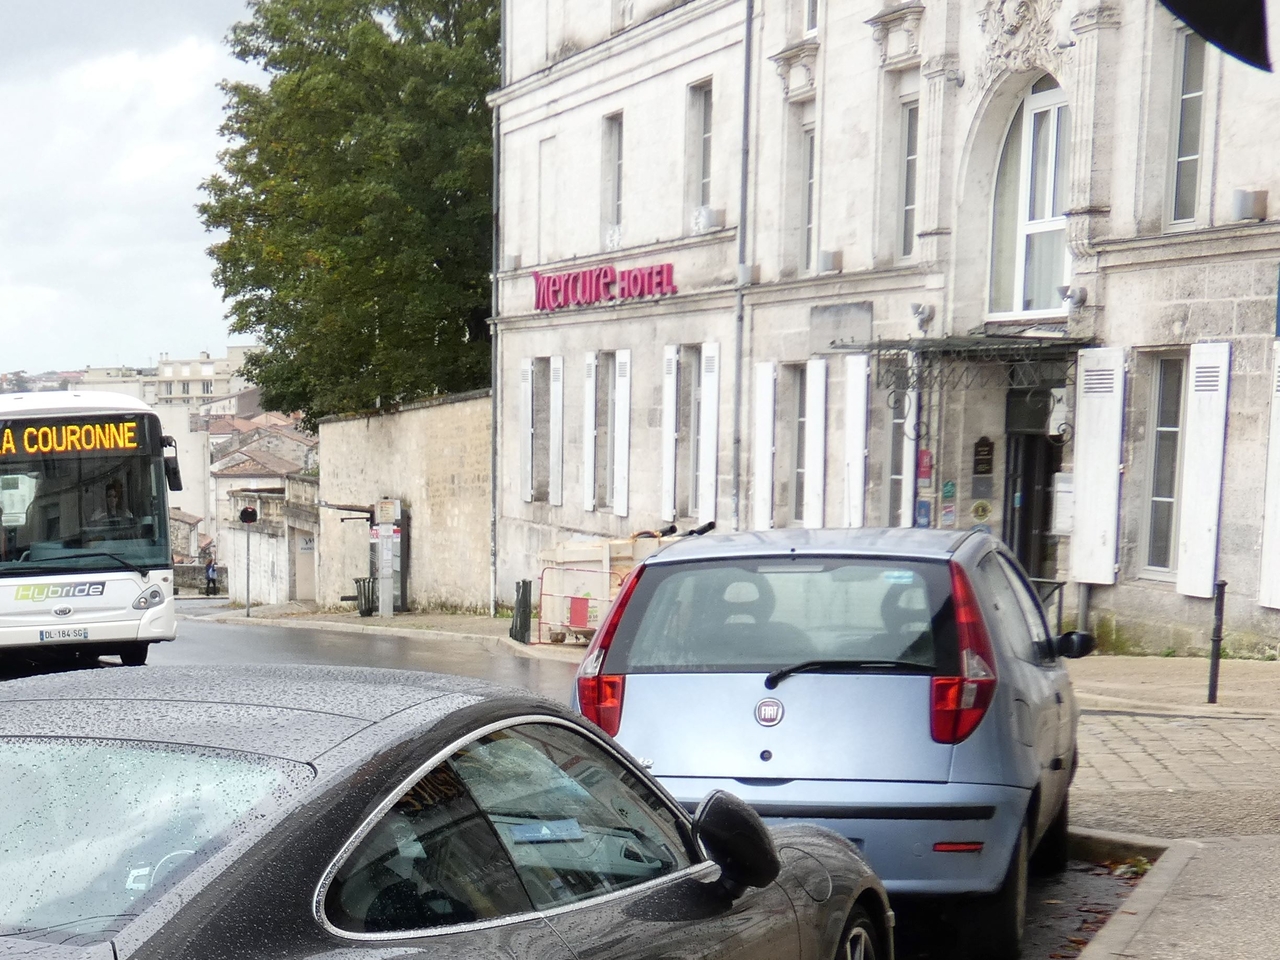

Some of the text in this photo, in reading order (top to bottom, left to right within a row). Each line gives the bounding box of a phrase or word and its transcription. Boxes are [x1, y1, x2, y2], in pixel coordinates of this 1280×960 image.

[617, 263, 678, 298] HOTEL
[23, 421, 138, 453] COURONNE
[18, 583, 103, 602] Hybride
[761, 706, 778, 719] FIAT
